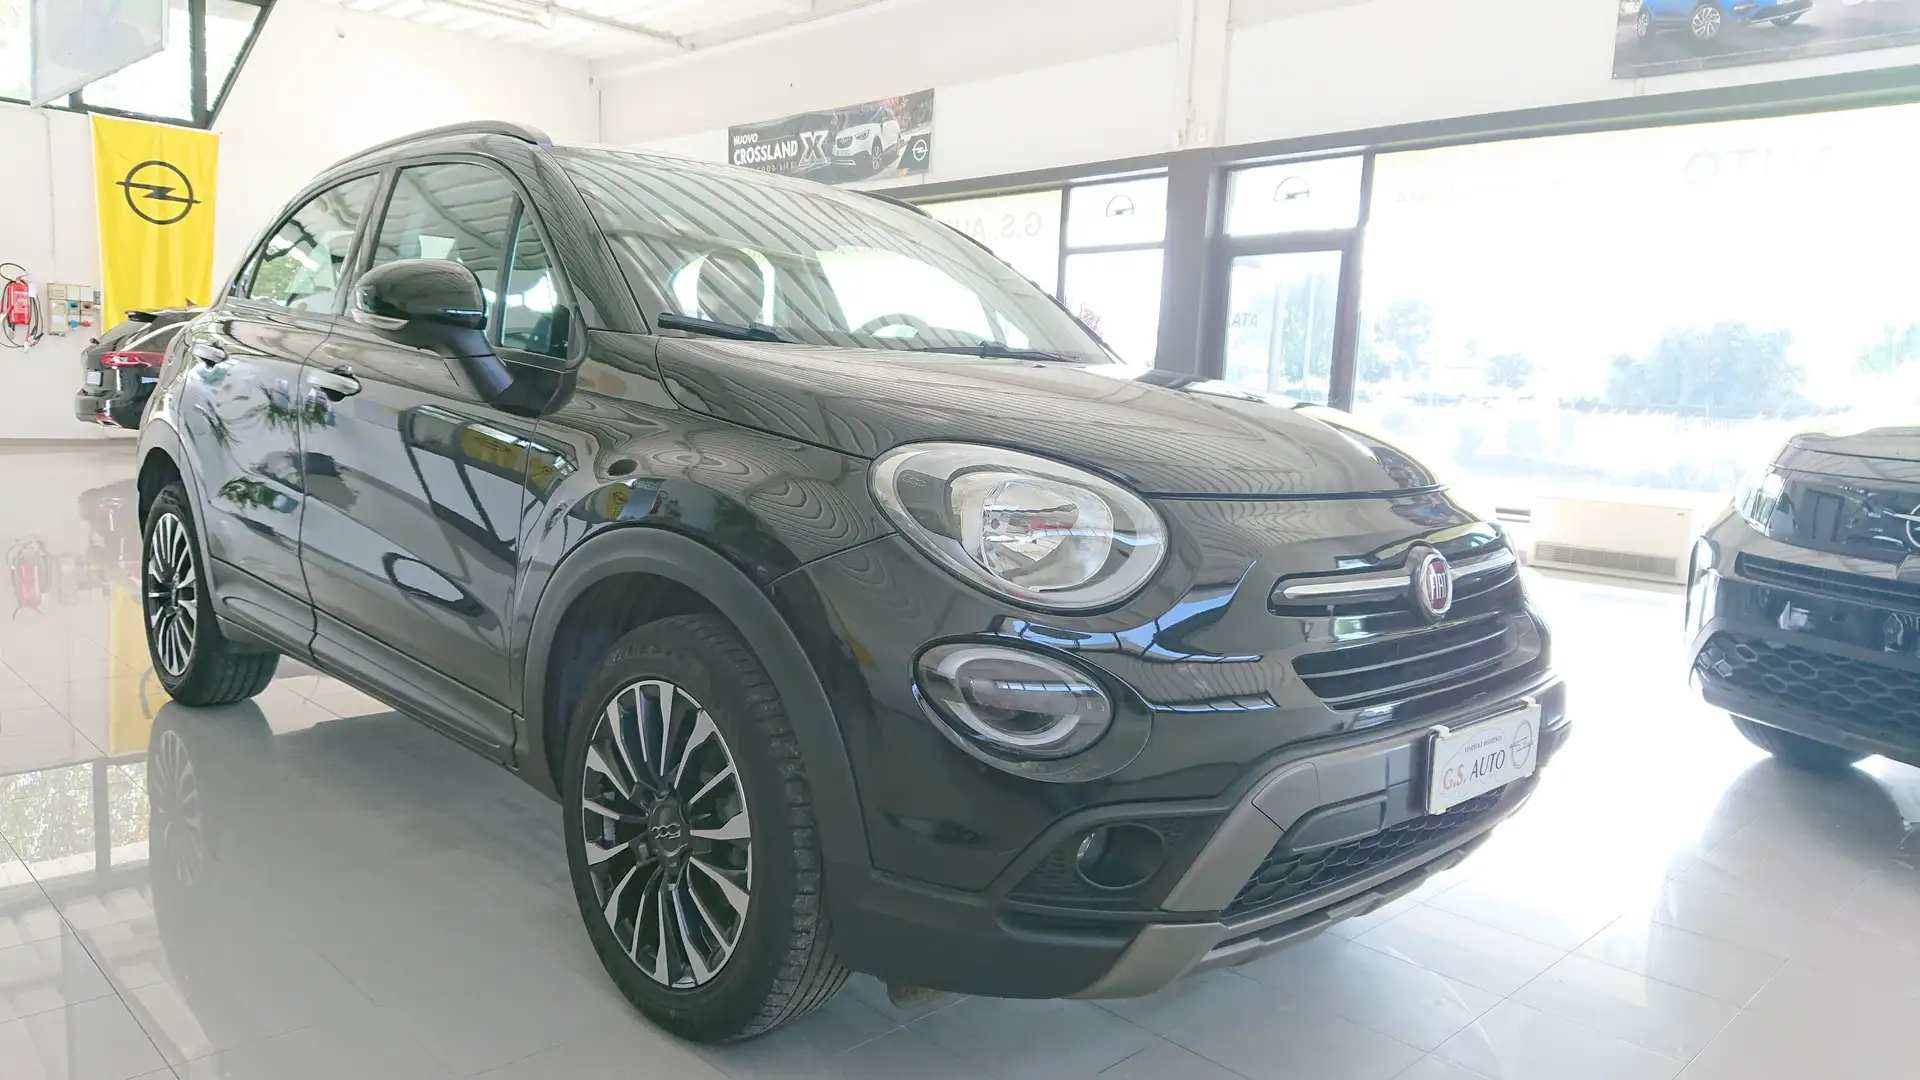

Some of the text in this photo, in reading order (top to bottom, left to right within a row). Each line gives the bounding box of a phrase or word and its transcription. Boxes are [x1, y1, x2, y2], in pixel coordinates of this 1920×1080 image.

[733, 133, 757, 146] NUOVO
[734, 130, 829, 167] CROSSLAND X
[1430, 573, 1447, 599] FIAT
[1443, 749, 1505, 791] G.S. AUTO
